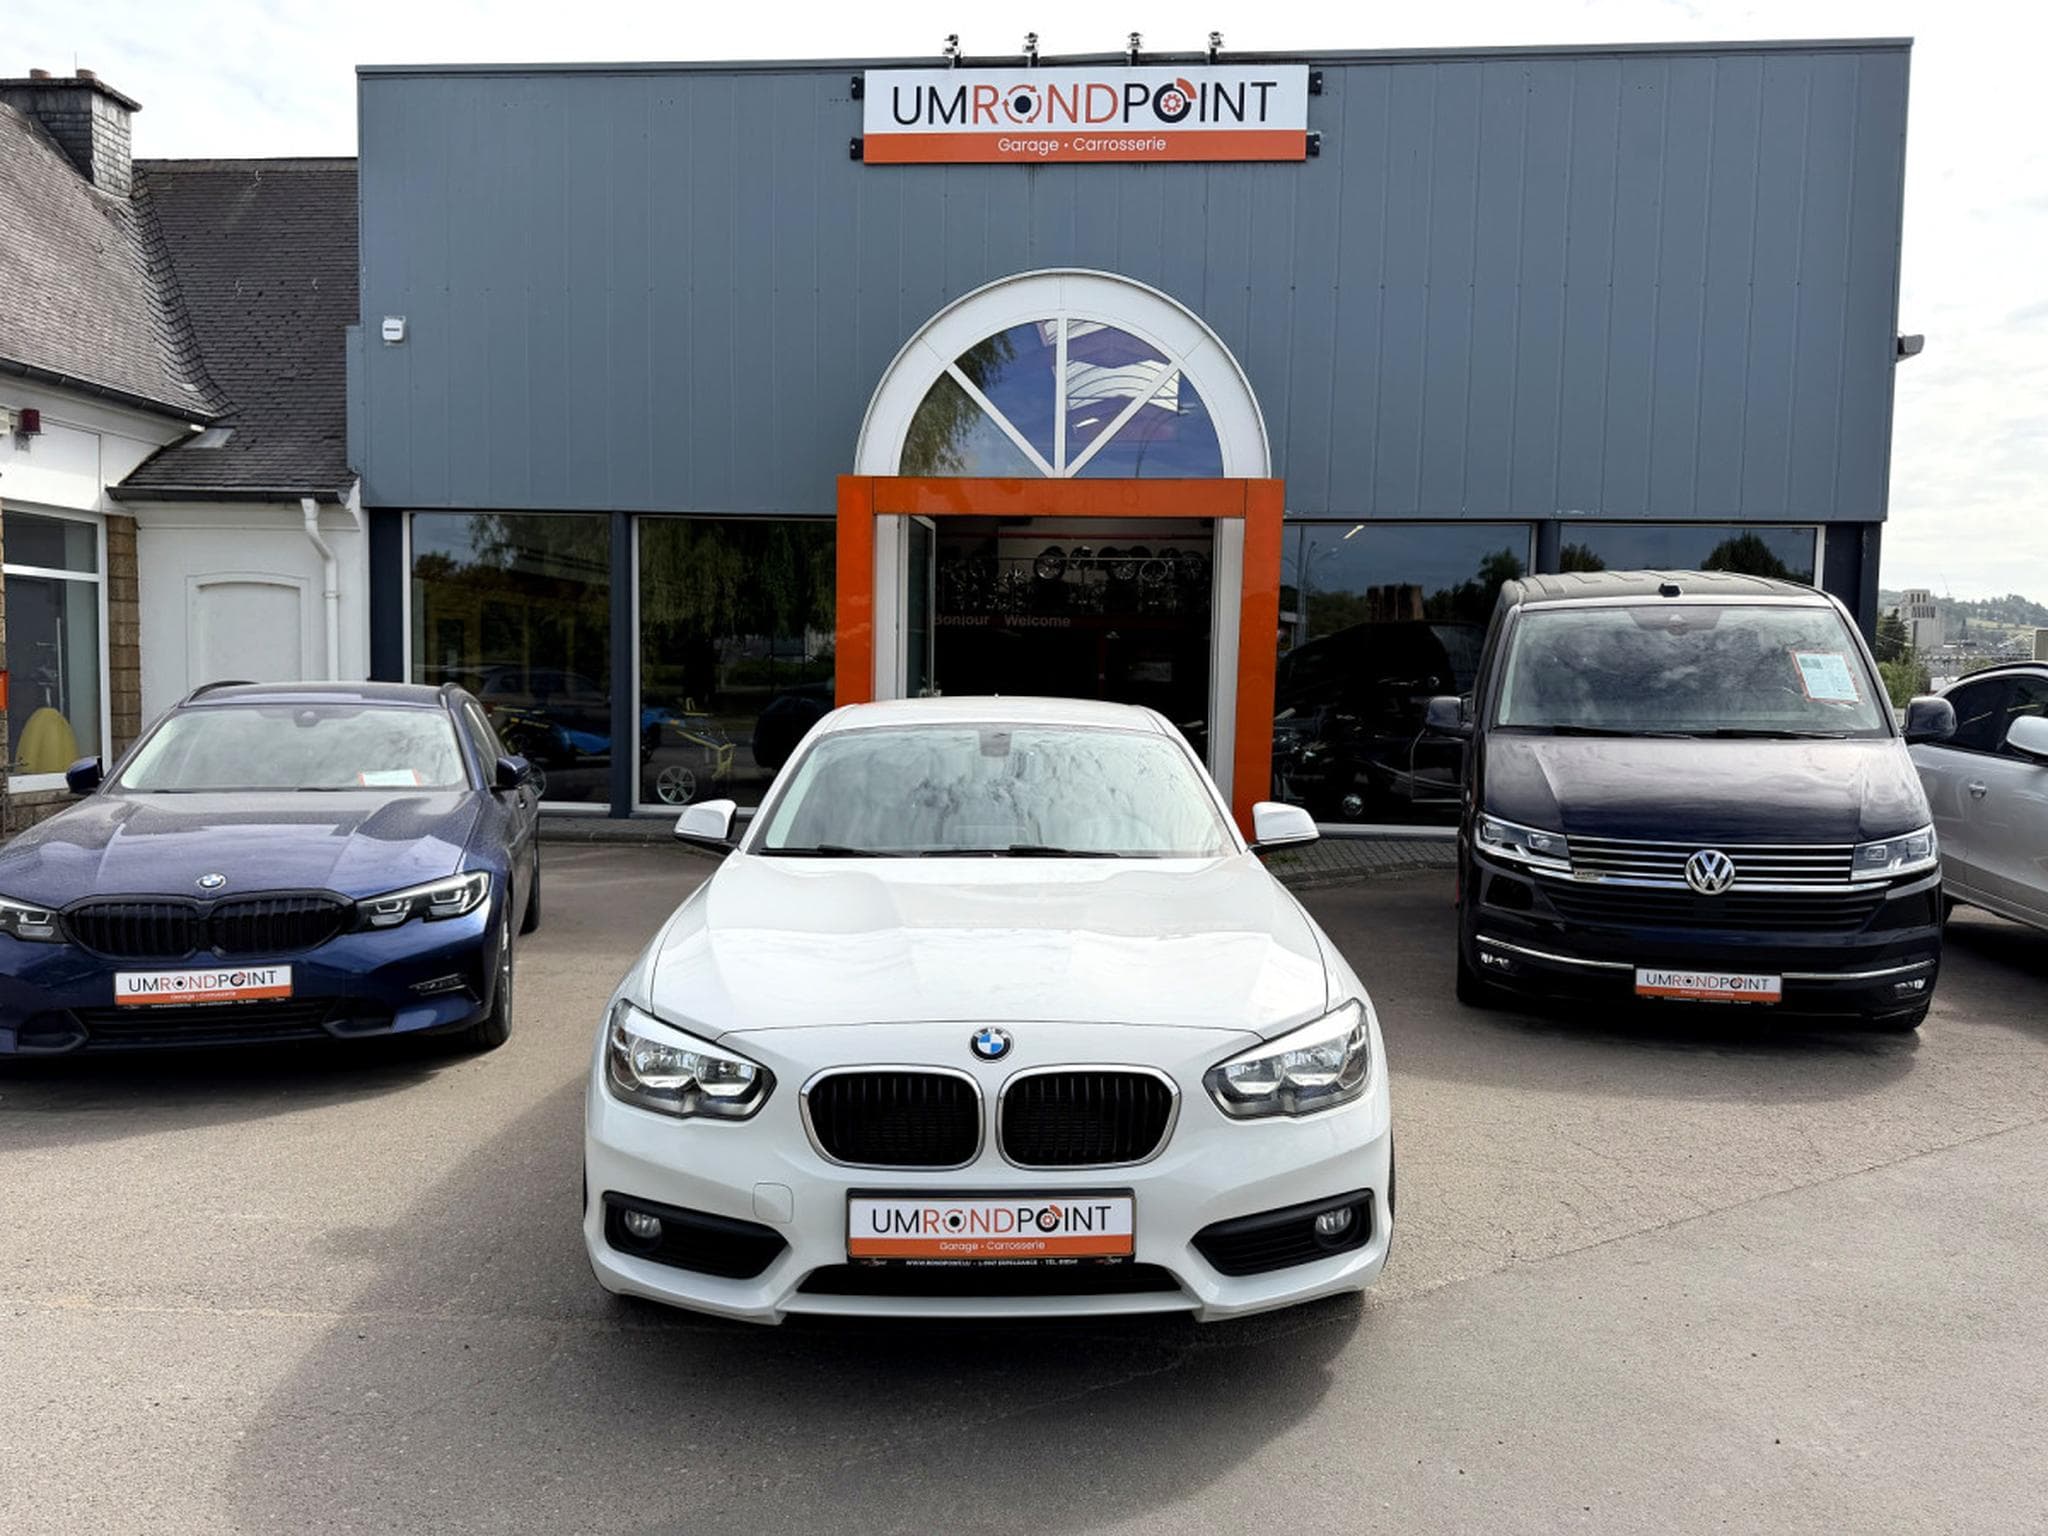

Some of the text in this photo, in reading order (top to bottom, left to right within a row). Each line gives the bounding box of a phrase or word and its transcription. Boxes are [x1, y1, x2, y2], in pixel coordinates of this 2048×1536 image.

[998, 136, 1166, 155] Garage Carrosserie
[1004, 614, 1072, 627] Welcome
[939, 1240, 1046, 1253] Garage Carrosserie
